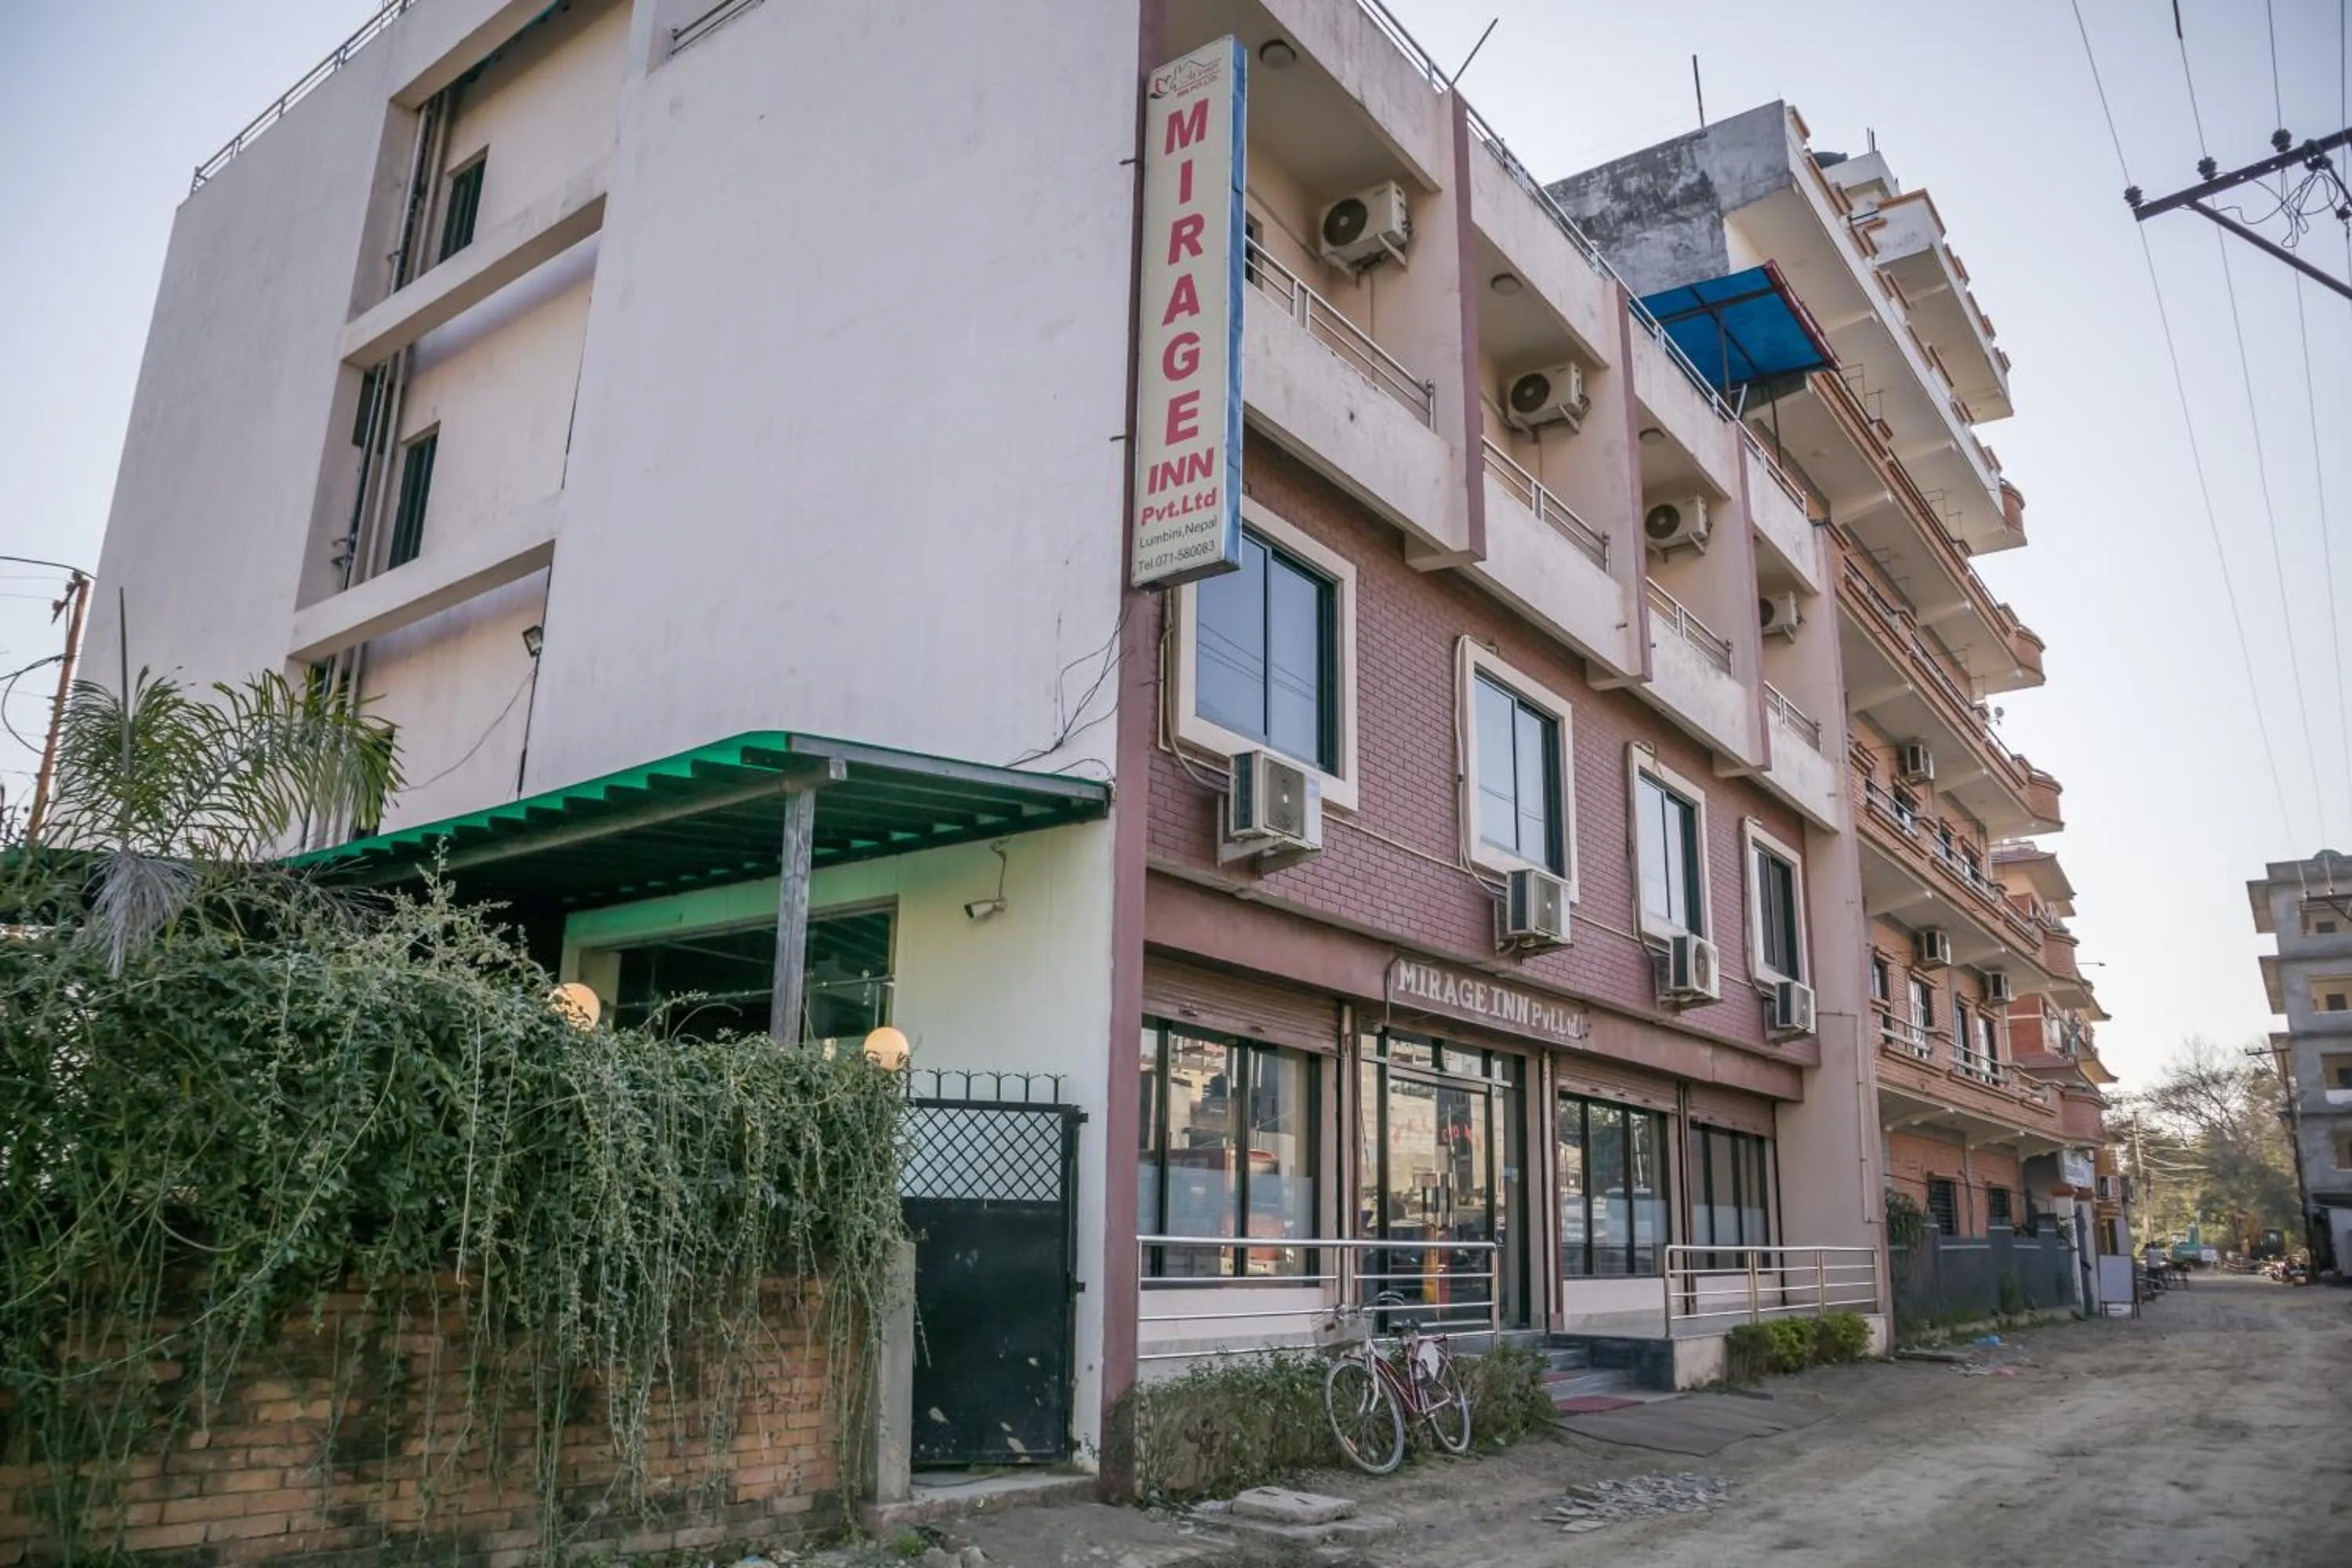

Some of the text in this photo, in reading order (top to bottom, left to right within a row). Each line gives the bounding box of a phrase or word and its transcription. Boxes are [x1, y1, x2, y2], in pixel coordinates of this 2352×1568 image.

[1161, 98, 1209, 446] MIRAGE
[1148, 447, 1214, 495] INN
[1398, 959, 1488, 1013] MIRAGE
[1489, 985, 1529, 1025] INN
